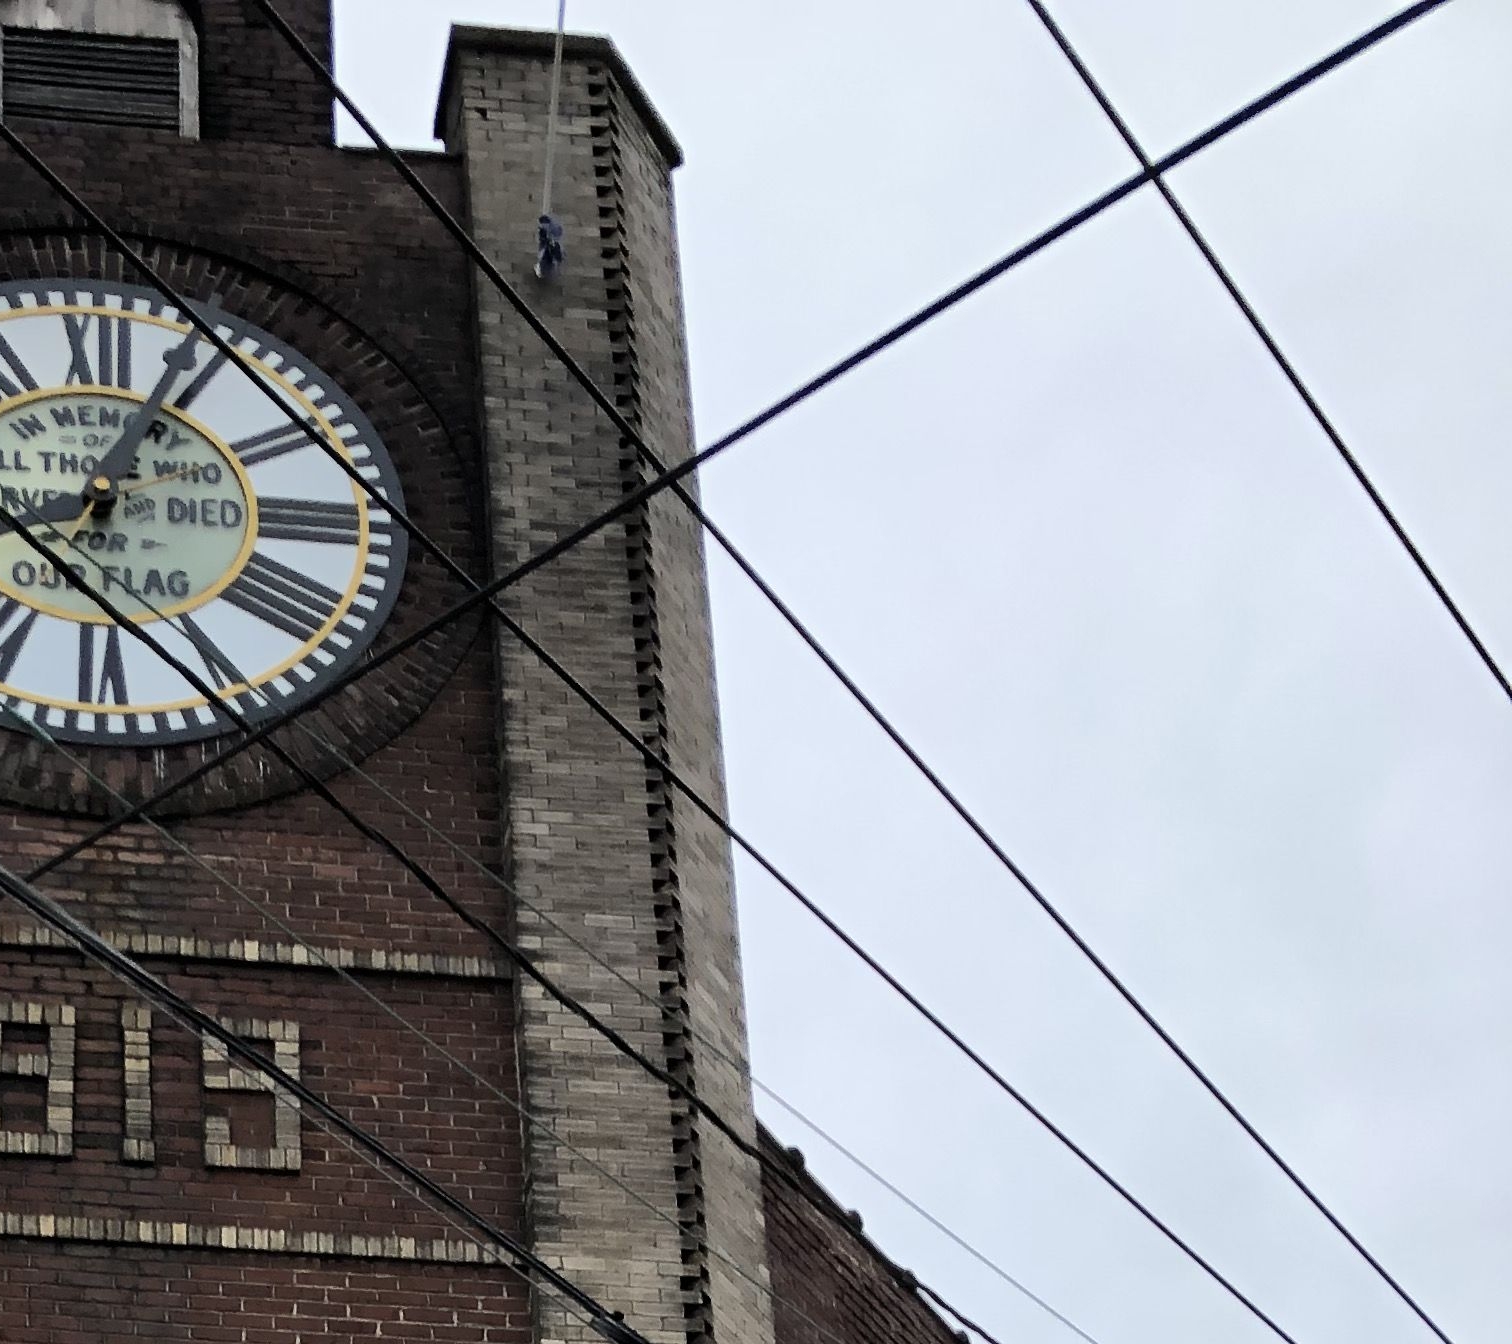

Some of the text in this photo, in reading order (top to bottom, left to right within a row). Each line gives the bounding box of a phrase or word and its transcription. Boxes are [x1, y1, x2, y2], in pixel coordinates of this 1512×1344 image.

[62, 313, 131, 391] XII
[9, 413, 46, 440] IN
[82, 433, 112, 447] OF
[37, 451, 141, 480] THOE
[152, 460, 222, 485] WHO
[167, 497, 242, 528] DIED
[72, 530, 128, 551] FOR
[12, 560, 190, 597] OUR FLAG
